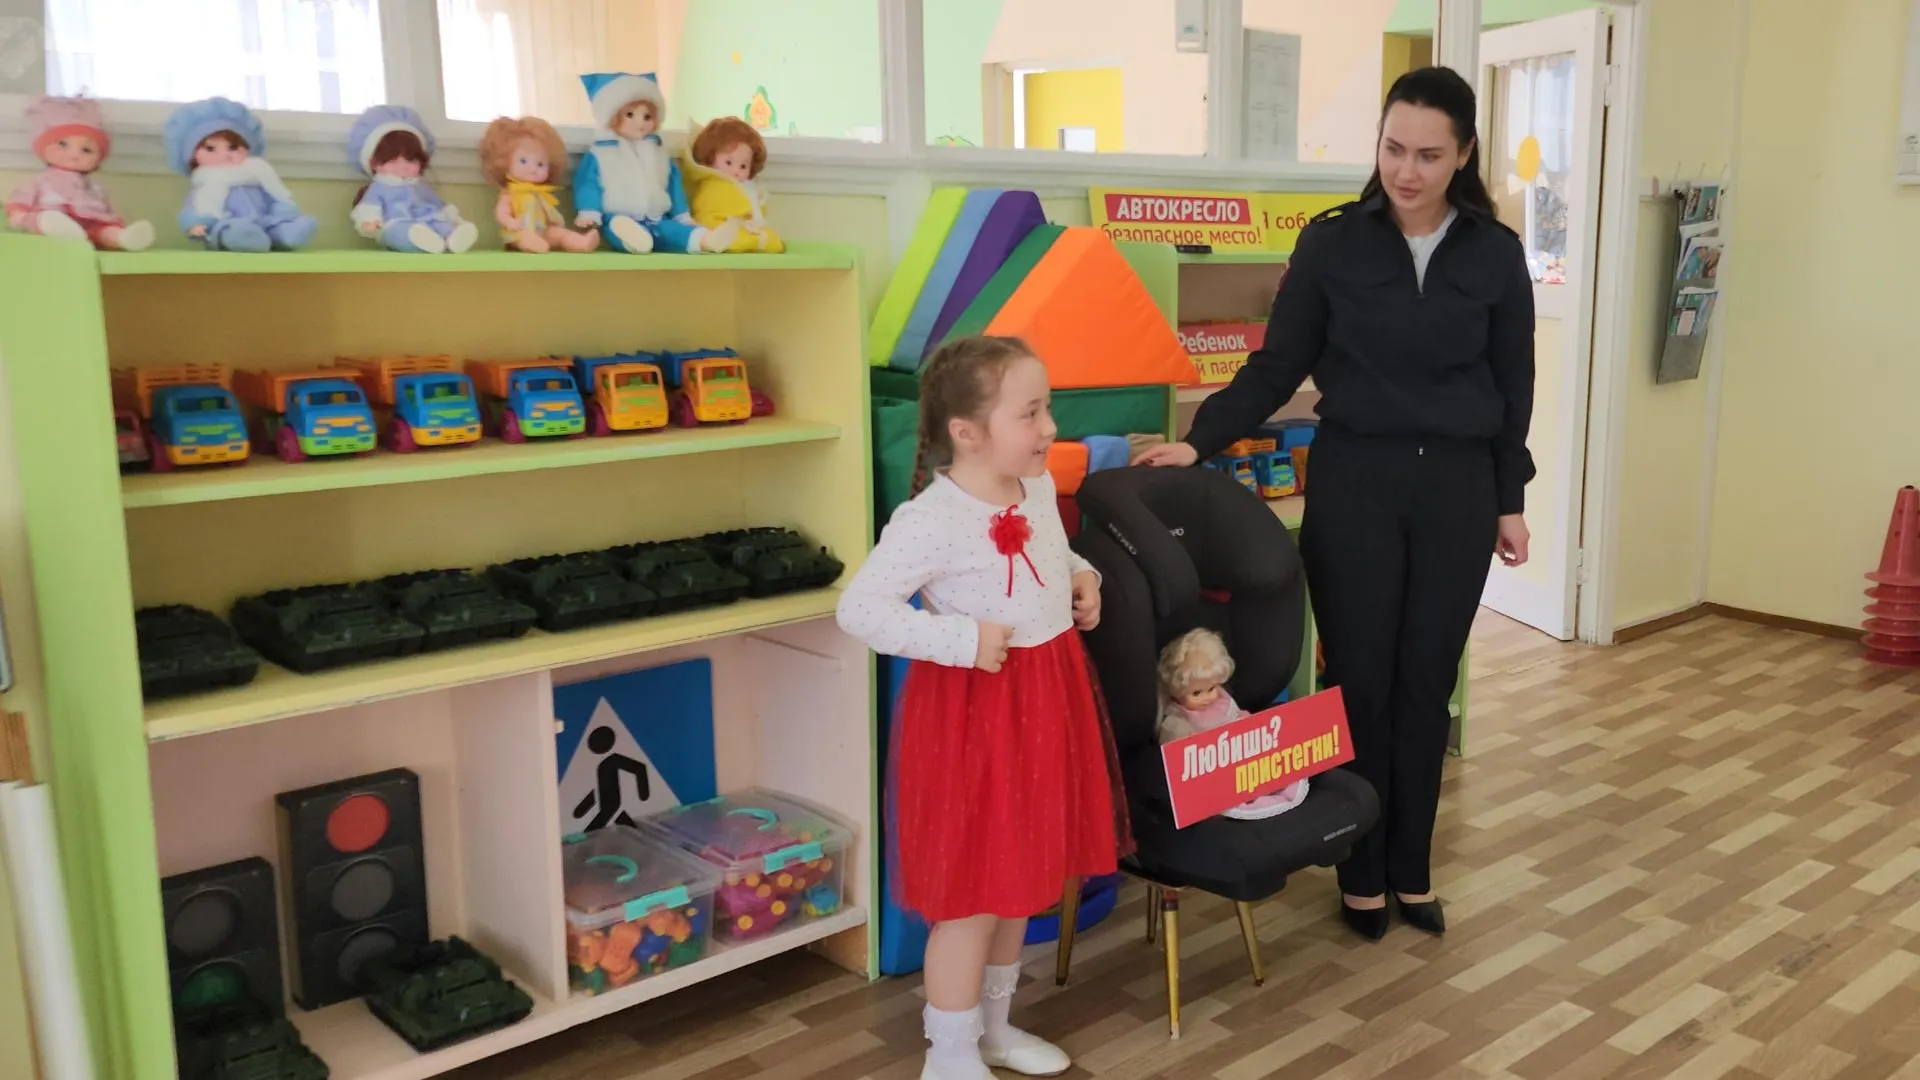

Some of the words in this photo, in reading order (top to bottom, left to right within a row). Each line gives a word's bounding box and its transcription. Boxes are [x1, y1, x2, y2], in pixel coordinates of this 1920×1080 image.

[1116, 197, 1240, 222] АВТОКРЕСЛО
[1276, 211, 1308, 230] соб
[1101, 223, 1204, 245] безопасное
[1209, 226, 1262, 245] место!
[1210, 360, 1245, 376] пасс
[1181, 715, 1282, 782] Любишь?
[1235, 724, 1340, 794] пристегни!
